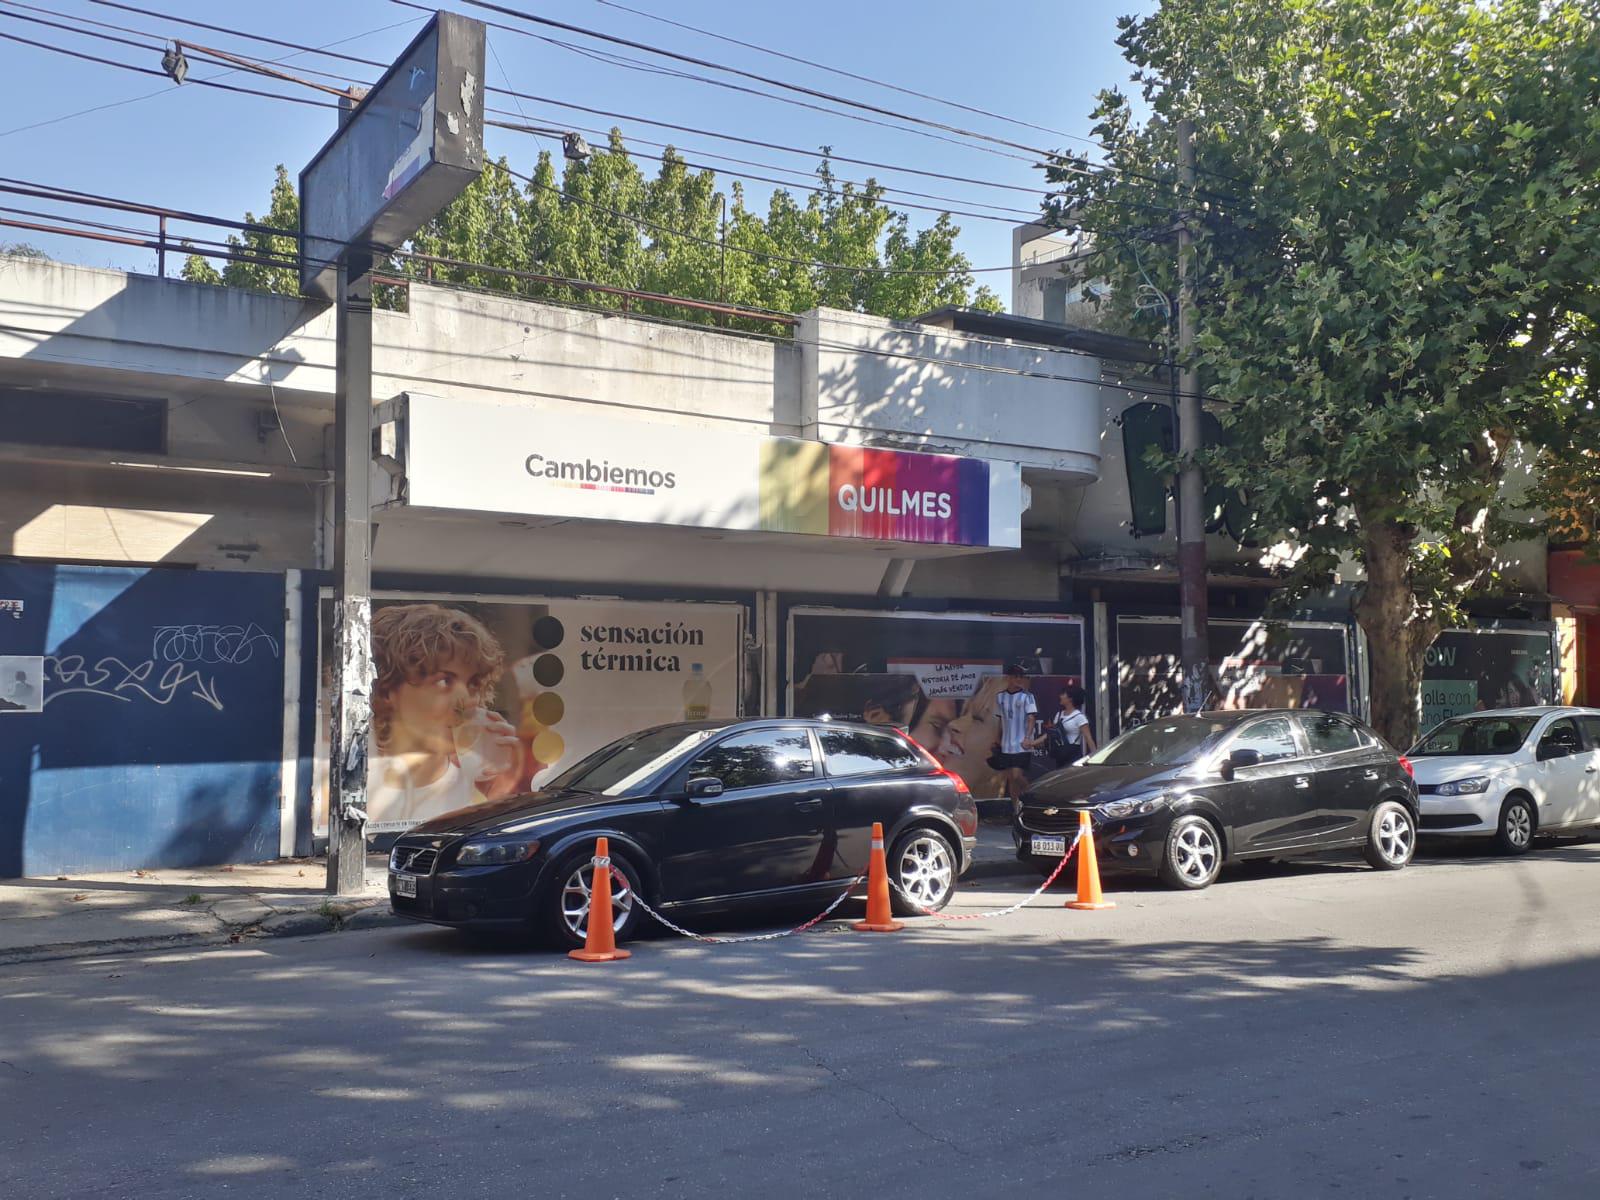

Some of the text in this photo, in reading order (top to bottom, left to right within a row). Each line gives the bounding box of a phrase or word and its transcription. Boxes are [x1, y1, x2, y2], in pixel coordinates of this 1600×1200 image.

[525, 453, 676, 489] Cambiemos
[838, 484, 952, 518] QUILMES
[580, 621, 704, 646] sensación
[580, 646, 681, 672] térmica
